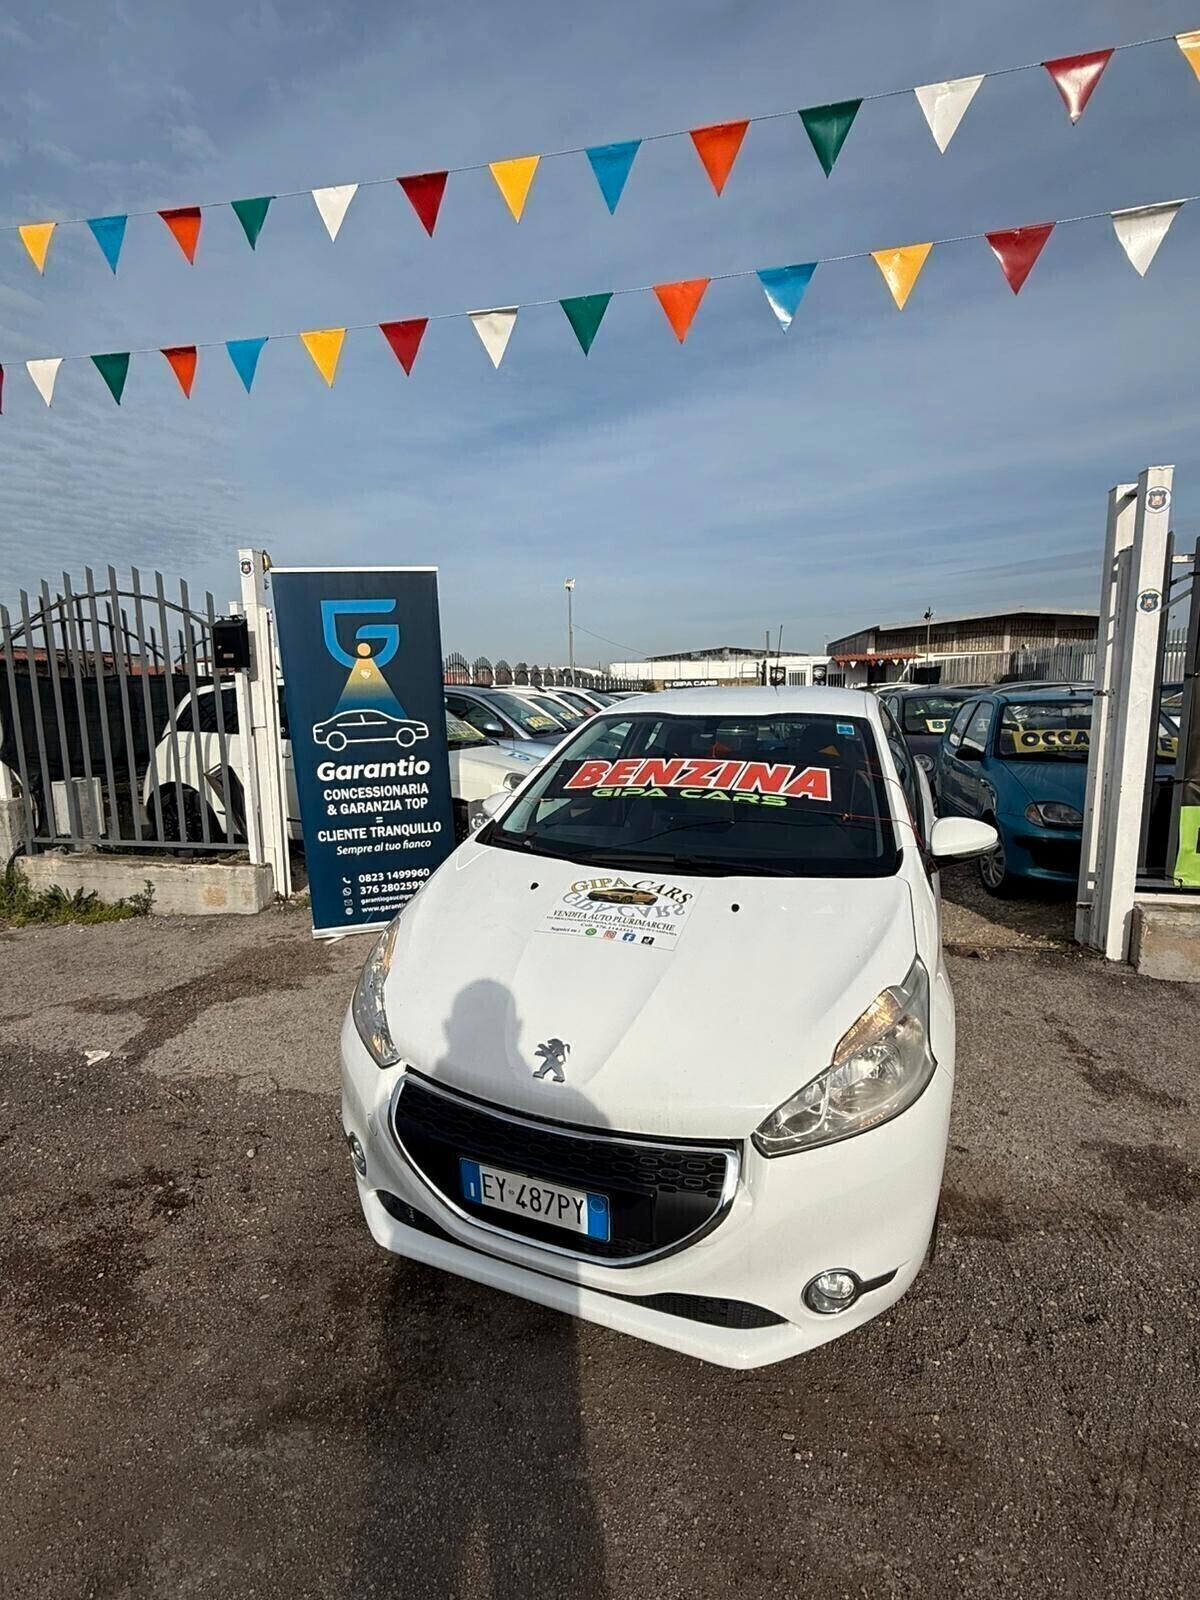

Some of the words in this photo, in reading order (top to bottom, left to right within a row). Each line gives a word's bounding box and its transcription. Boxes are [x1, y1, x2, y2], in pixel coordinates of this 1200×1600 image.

[317, 755, 430, 781] Garantio
[563, 758, 832, 802] BENZINA
[323, 782, 429, 801] CONCESSIONARIA
[592, 787, 667, 797] GIPA
[679, 788, 788, 807] CARS
[327, 804, 337, 816] &
[340, 799, 402, 815] GARANZIA
[405, 797, 428, 810] TOP
[317, 827, 367, 842] CLIENTE
[370, 821, 441, 838] TRANQUILLO
[336, 845, 373, 856] Sempre
[374, 842, 383, 852] al
[385, 842, 401, 850] tuo
[402, 839, 432, 850] fianco
[358, 873, 384, 883] 0823
[386, 868, 430, 880] 1499960
[360, 885, 379, 895] 376
[381, 881, 425, 893] 2802599
[553, 910, 587, 920] VENDITA
[589, 914, 612, 923] AUTO
[611, 915, 676, 931] PLURIMARCHE
[482, 1173, 506, 1202] EY
[516, 1184, 584, 1224] 487PY
